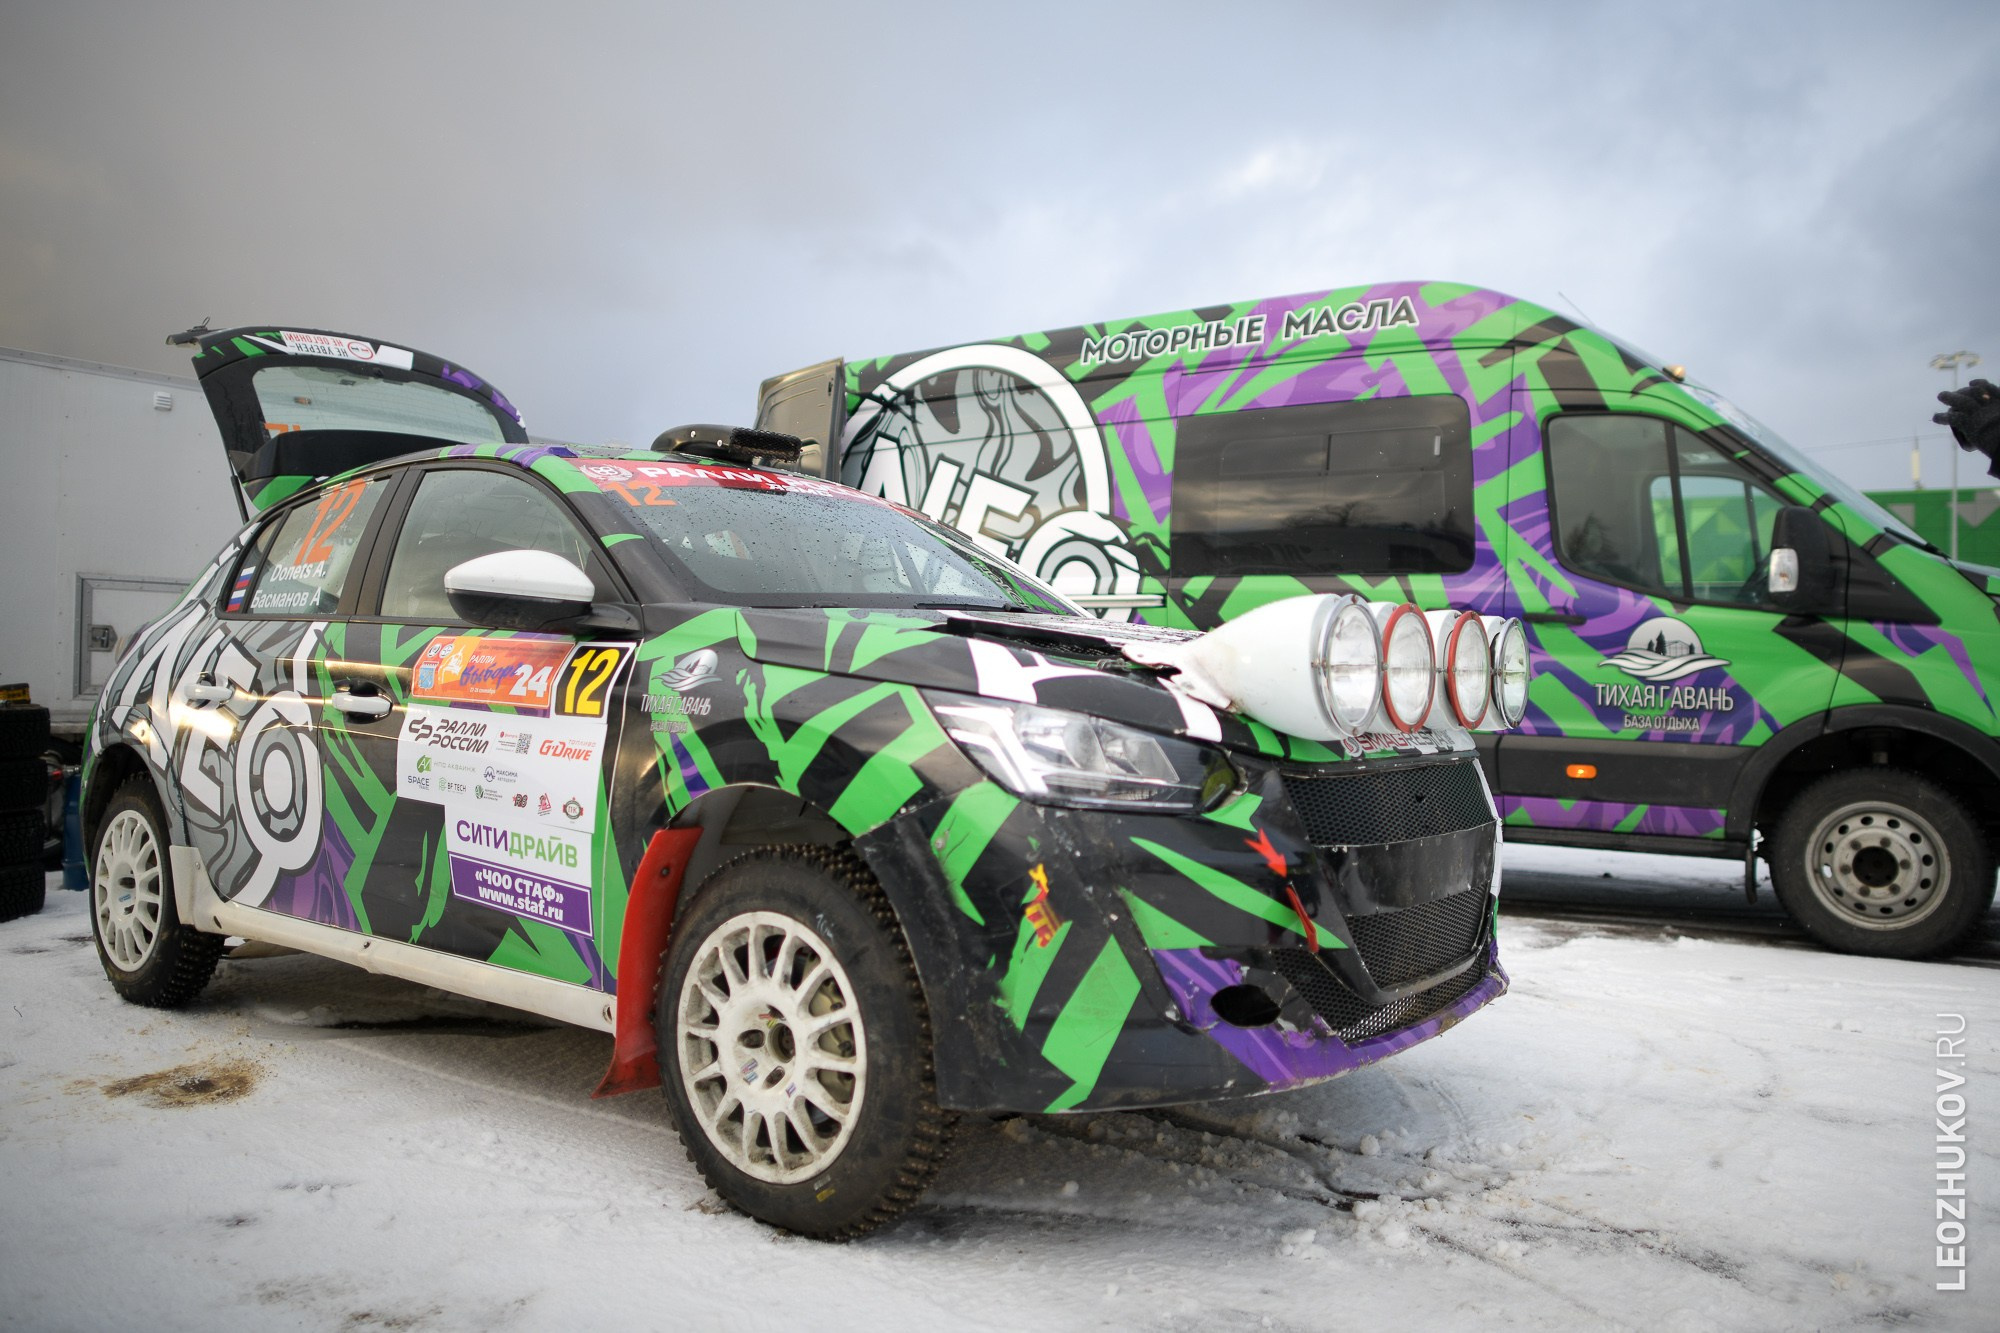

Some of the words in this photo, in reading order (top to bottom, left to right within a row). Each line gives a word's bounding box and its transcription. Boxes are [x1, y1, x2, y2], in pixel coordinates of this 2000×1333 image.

[1081, 314, 1268, 366] МОТОРНЫЕ
[1282, 296, 1421, 342] МАСЛА
[603, 481, 678, 507] 12
[293, 478, 367, 566] 12
[270, 563, 312, 583] Donets
[250, 590, 310, 609] Басманов
[469, 655, 496, 664] РАЛЛИ
[509, 664, 554, 698] 24
[564, 648, 620, 715] 12
[640, 694, 671, 715] ТИХАЯ
[671, 695, 712, 716] ГАВАНЬ
[1594, 683, 1656, 708] ТИХАЯ
[1660, 685, 1735, 711] ГАВАНЬ
[436, 718, 487, 737] РАЛЛИ
[1624, 714, 1652, 729] БАЗА
[1654, 715, 1700, 731] ОТДЫХА
[428, 733, 489, 754] РОССИИ
[408, 775, 430, 787] SPACE
[496, 769, 518, 778] МАКСИМА
[454, 783, 467, 793] TECH
[456, 819, 578, 868] СИТИДРАЙВ
[478, 886, 564, 922] www.staf.ru
